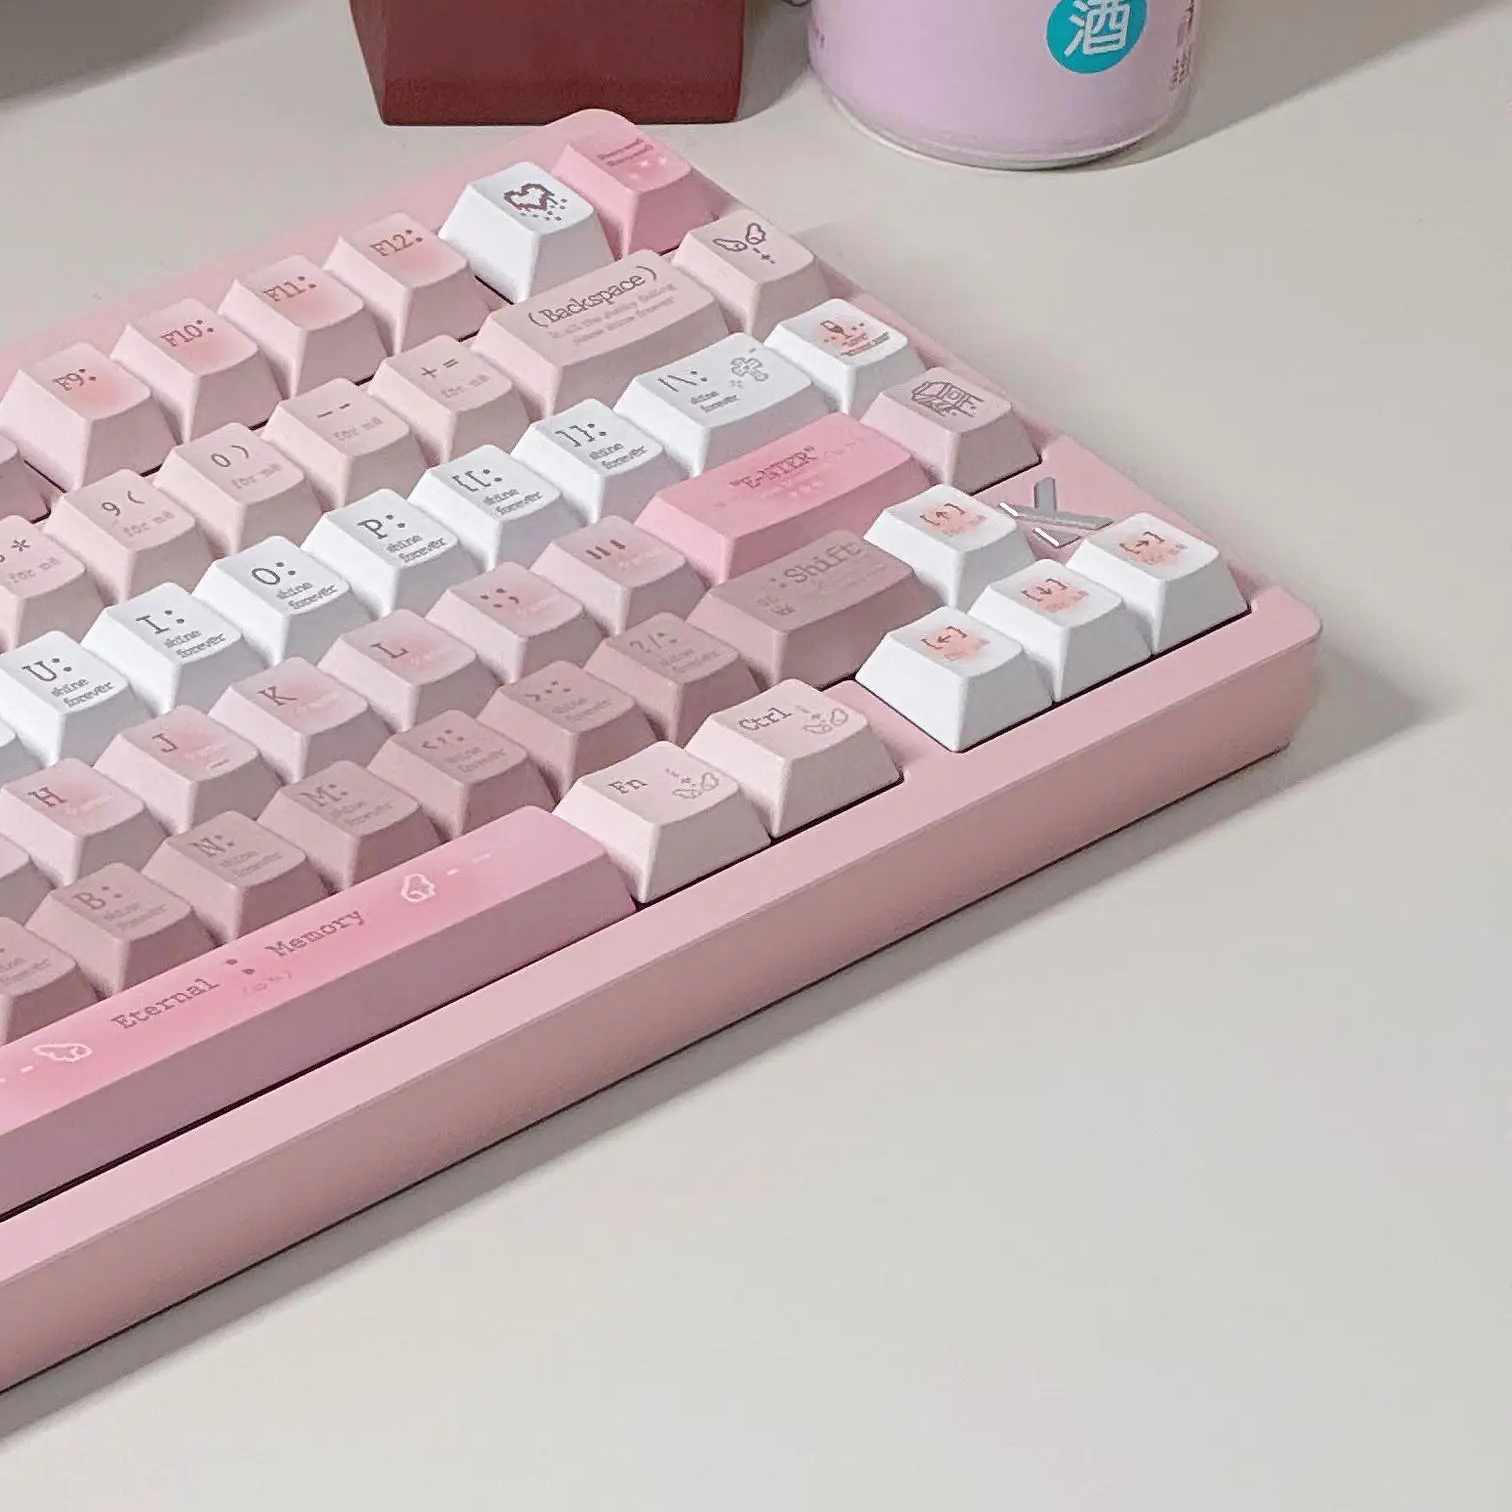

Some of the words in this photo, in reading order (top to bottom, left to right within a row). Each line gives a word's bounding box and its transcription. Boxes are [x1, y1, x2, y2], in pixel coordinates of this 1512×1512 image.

[496, 491, 543, 516] forever
[399, 538, 448, 563] forever
[289, 585, 339, 609] forever
[176, 633, 226, 658] forever
[372, 643, 408, 659] L
[63, 681, 114, 707] forever
[258, 686, 298, 706] K
[738, 707, 794, 731] Ctrl
[152, 733, 178, 753] J
[28, 787, 67, 807] H
[608, 778, 648, 794] Fn
[110, 977, 220, 1031] Eternal
[264, 908, 367, 960] Memory
